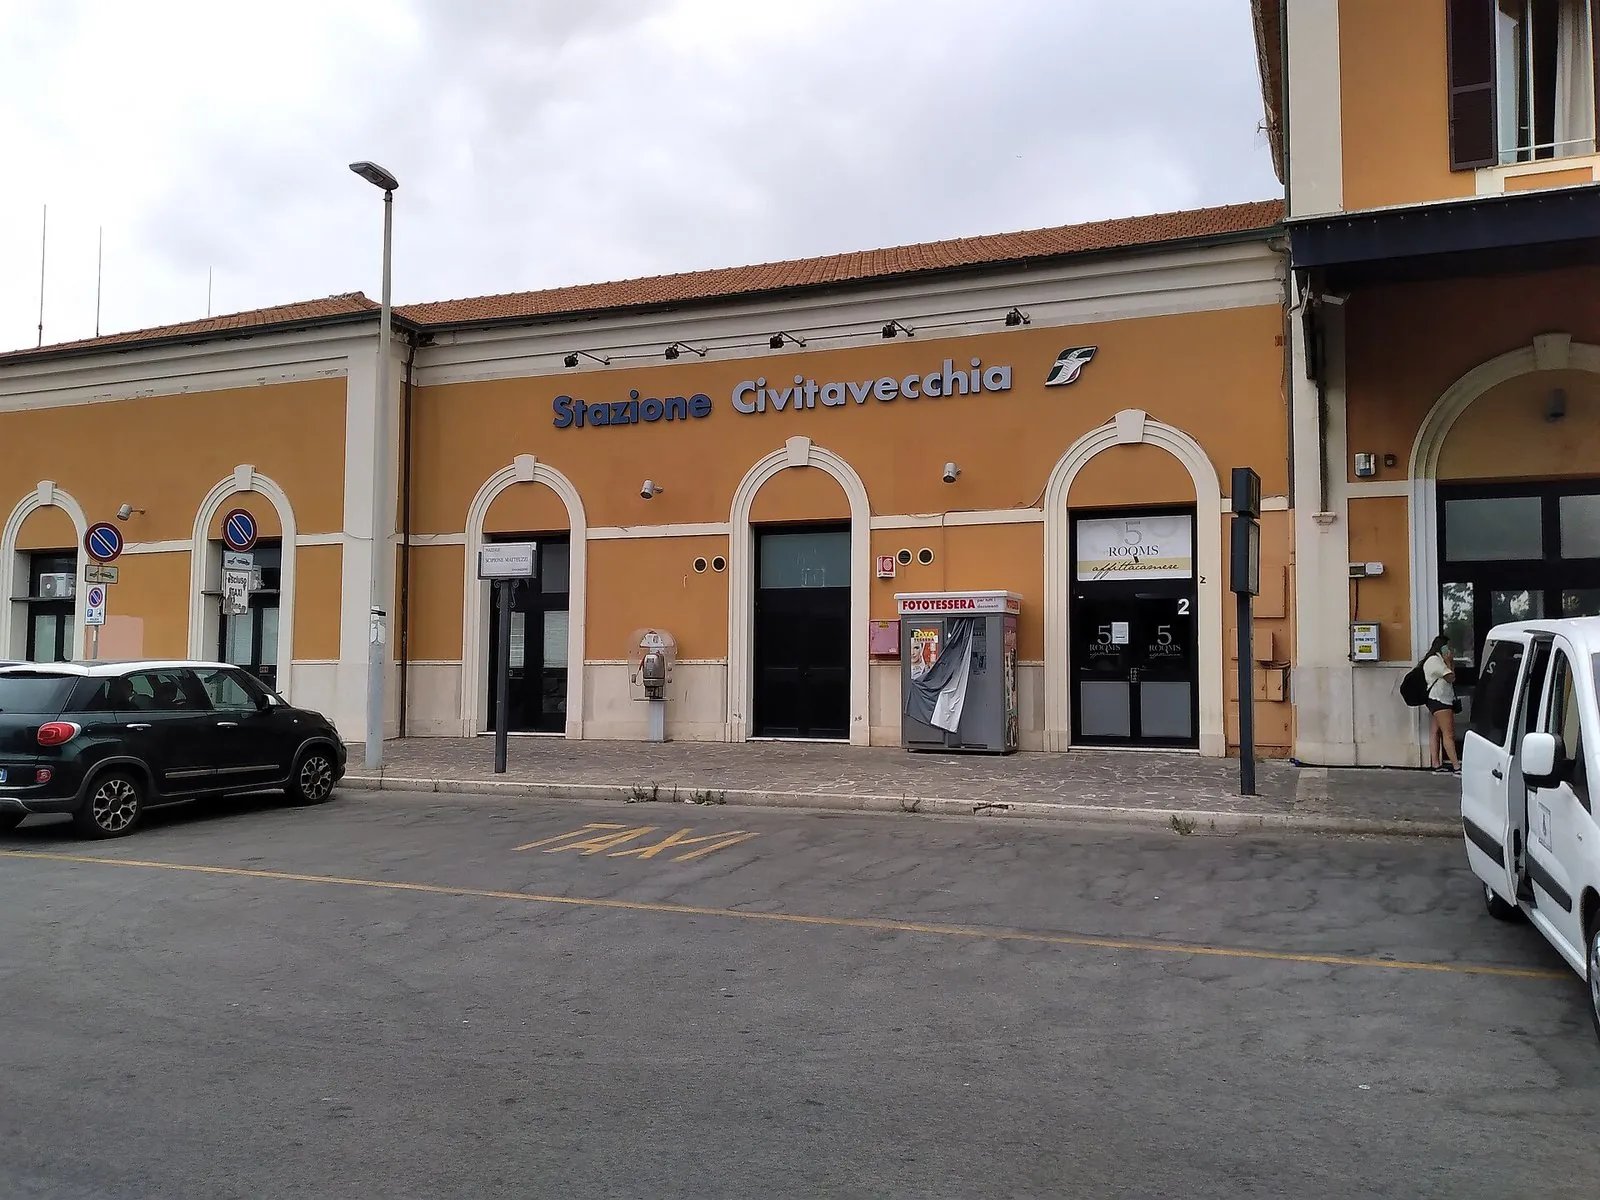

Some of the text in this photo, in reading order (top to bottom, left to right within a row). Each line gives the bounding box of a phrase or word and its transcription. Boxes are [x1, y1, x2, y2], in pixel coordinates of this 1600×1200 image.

[552, 357, 1012, 428] Stazione Civitavecchia
[1124, 521, 1142, 545] 5
[1108, 545, 1159, 557] ROOMS
[1092, 561, 1179, 579] affittacamere
[902, 599, 976, 610] FOTOTESSERA
[1178, 598, 1190, 615] 2
[1097, 625, 1111, 645] 5
[1157, 625, 1172, 645] 5
[1089, 644, 1121, 652] ROOMS
[1149, 644, 1181, 652] ROOMS
[509, 822, 761, 862] TAXI
